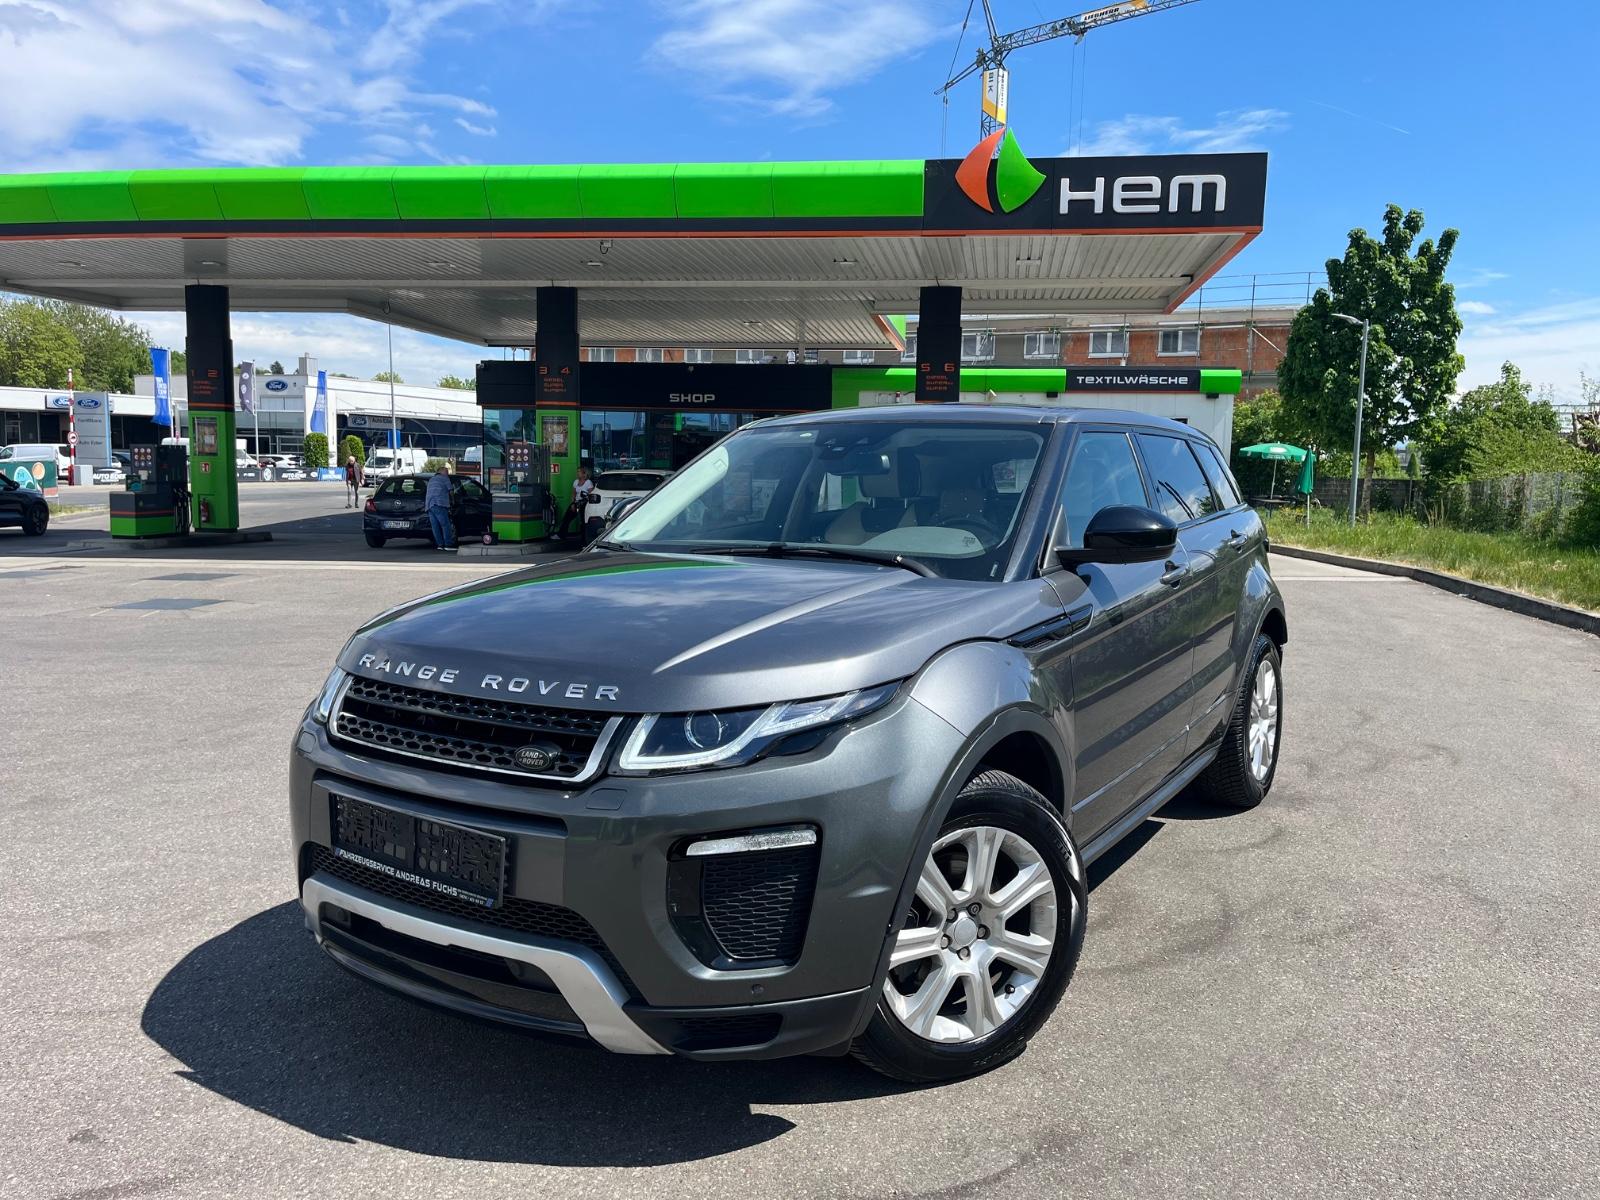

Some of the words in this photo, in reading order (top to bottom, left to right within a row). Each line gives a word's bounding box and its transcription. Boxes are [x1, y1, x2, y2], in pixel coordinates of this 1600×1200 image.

[1084, 8, 1119, 20] LIEBHERR
[539, 366, 548, 374] 3
[561, 366, 570, 375] 4
[920, 363, 930, 372] 5
[944, 363, 955, 372] 6
[669, 393, 716, 403] SHOP
[358, 653, 460, 683] RANGE
[480, 674, 619, 701] ROVER
[521, 750, 540, 759] LAND
[522, 757, 544, 766] ROVER
[340, 849, 394, 876] FAHRZEUGSERVICE
[395, 870, 431, 888] ANDREAS
[432, 881, 458, 896] FUCHS
